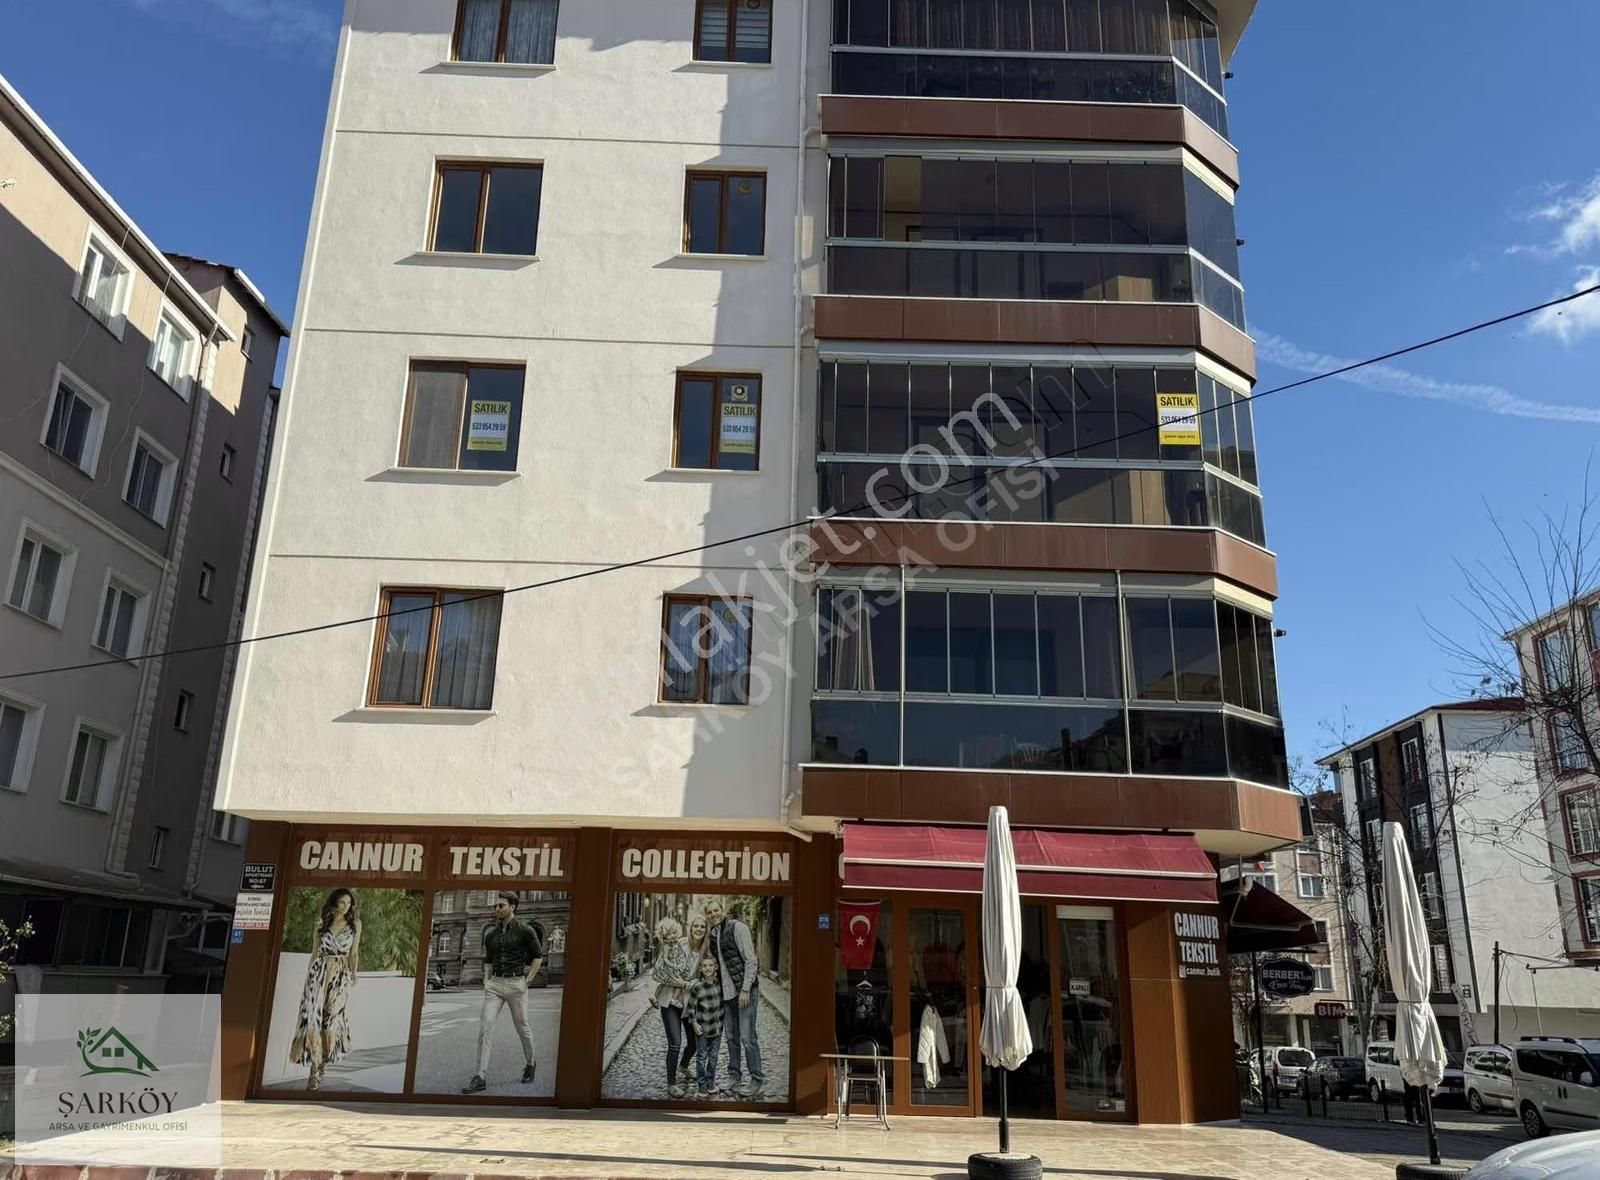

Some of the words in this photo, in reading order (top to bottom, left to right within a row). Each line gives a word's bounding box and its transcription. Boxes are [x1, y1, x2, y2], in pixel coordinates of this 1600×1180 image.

[474, 403, 507, 414] SATILIK
[1160, 396, 1194, 406] SATILIK
[723, 406, 756, 416] SATILIK
[299, 840, 424, 872] CANNUR
[449, 843, 564, 877] TEKSTİL
[621, 846, 790, 881] COLLECTİON
[1174, 912, 1220, 940] CANNUR
[1179, 940, 1219, 964] TEKSTİL
[1262, 969, 1300, 980] BERBER
[1318, 1003, 1344, 1017] BİM
